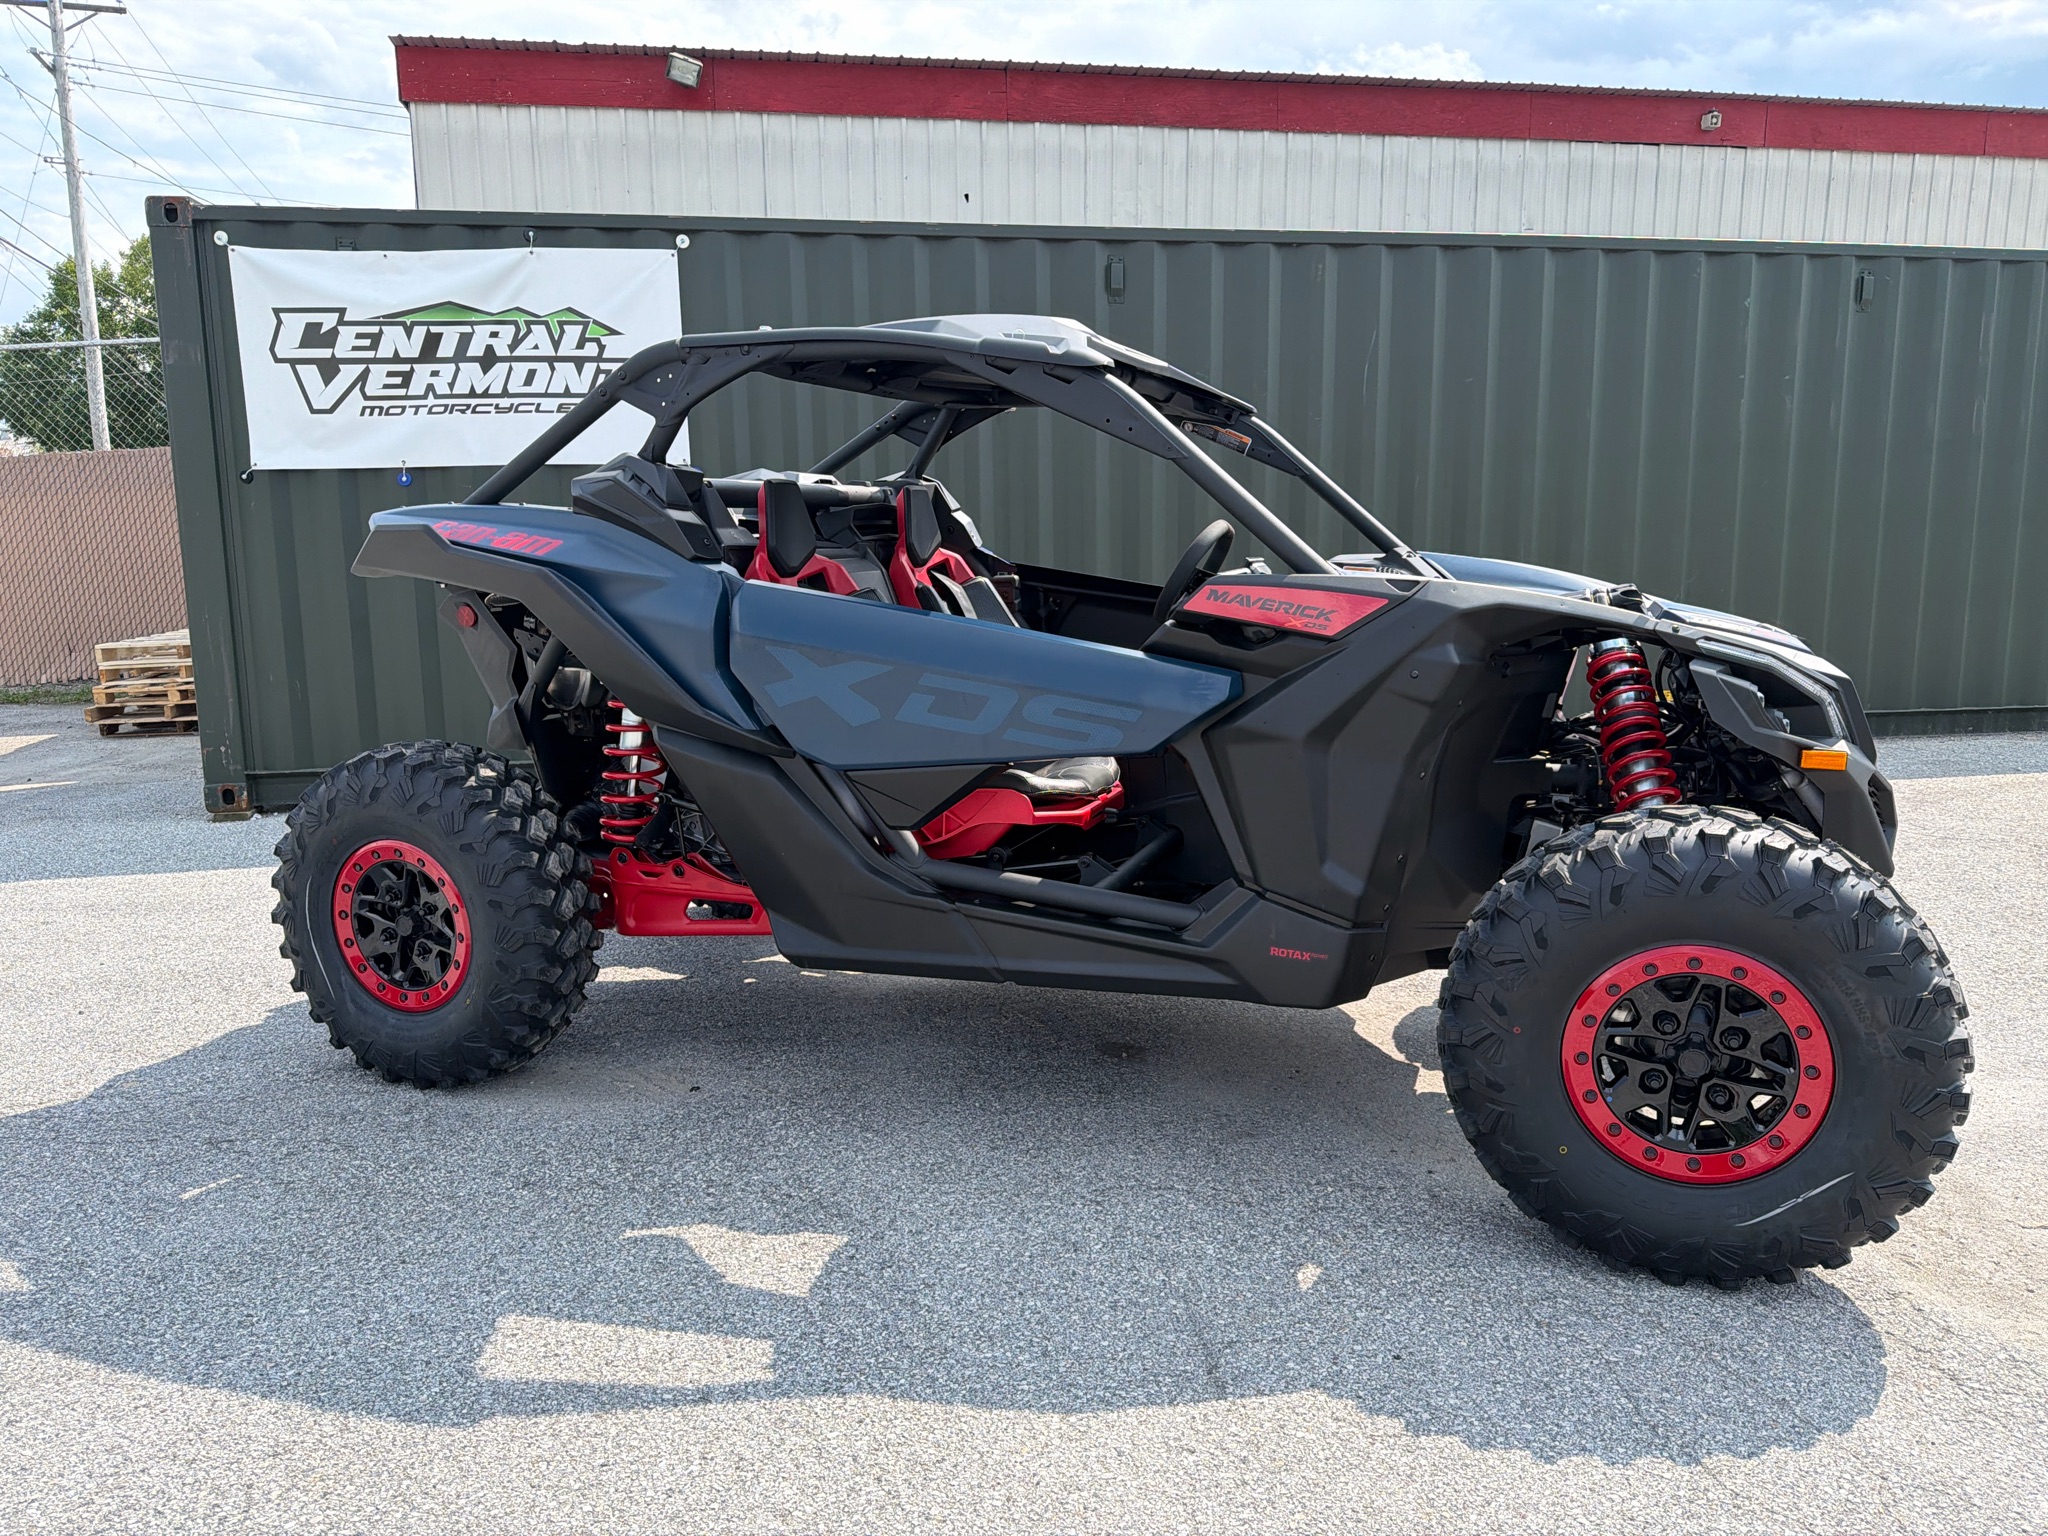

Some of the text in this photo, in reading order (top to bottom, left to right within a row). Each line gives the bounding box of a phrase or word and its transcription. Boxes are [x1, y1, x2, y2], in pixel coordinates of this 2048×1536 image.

[270, 308, 601, 359] CENTRAL
[1206, 589, 1338, 623] MAVERICK
[1270, 946, 1311, 961] ROTAX
